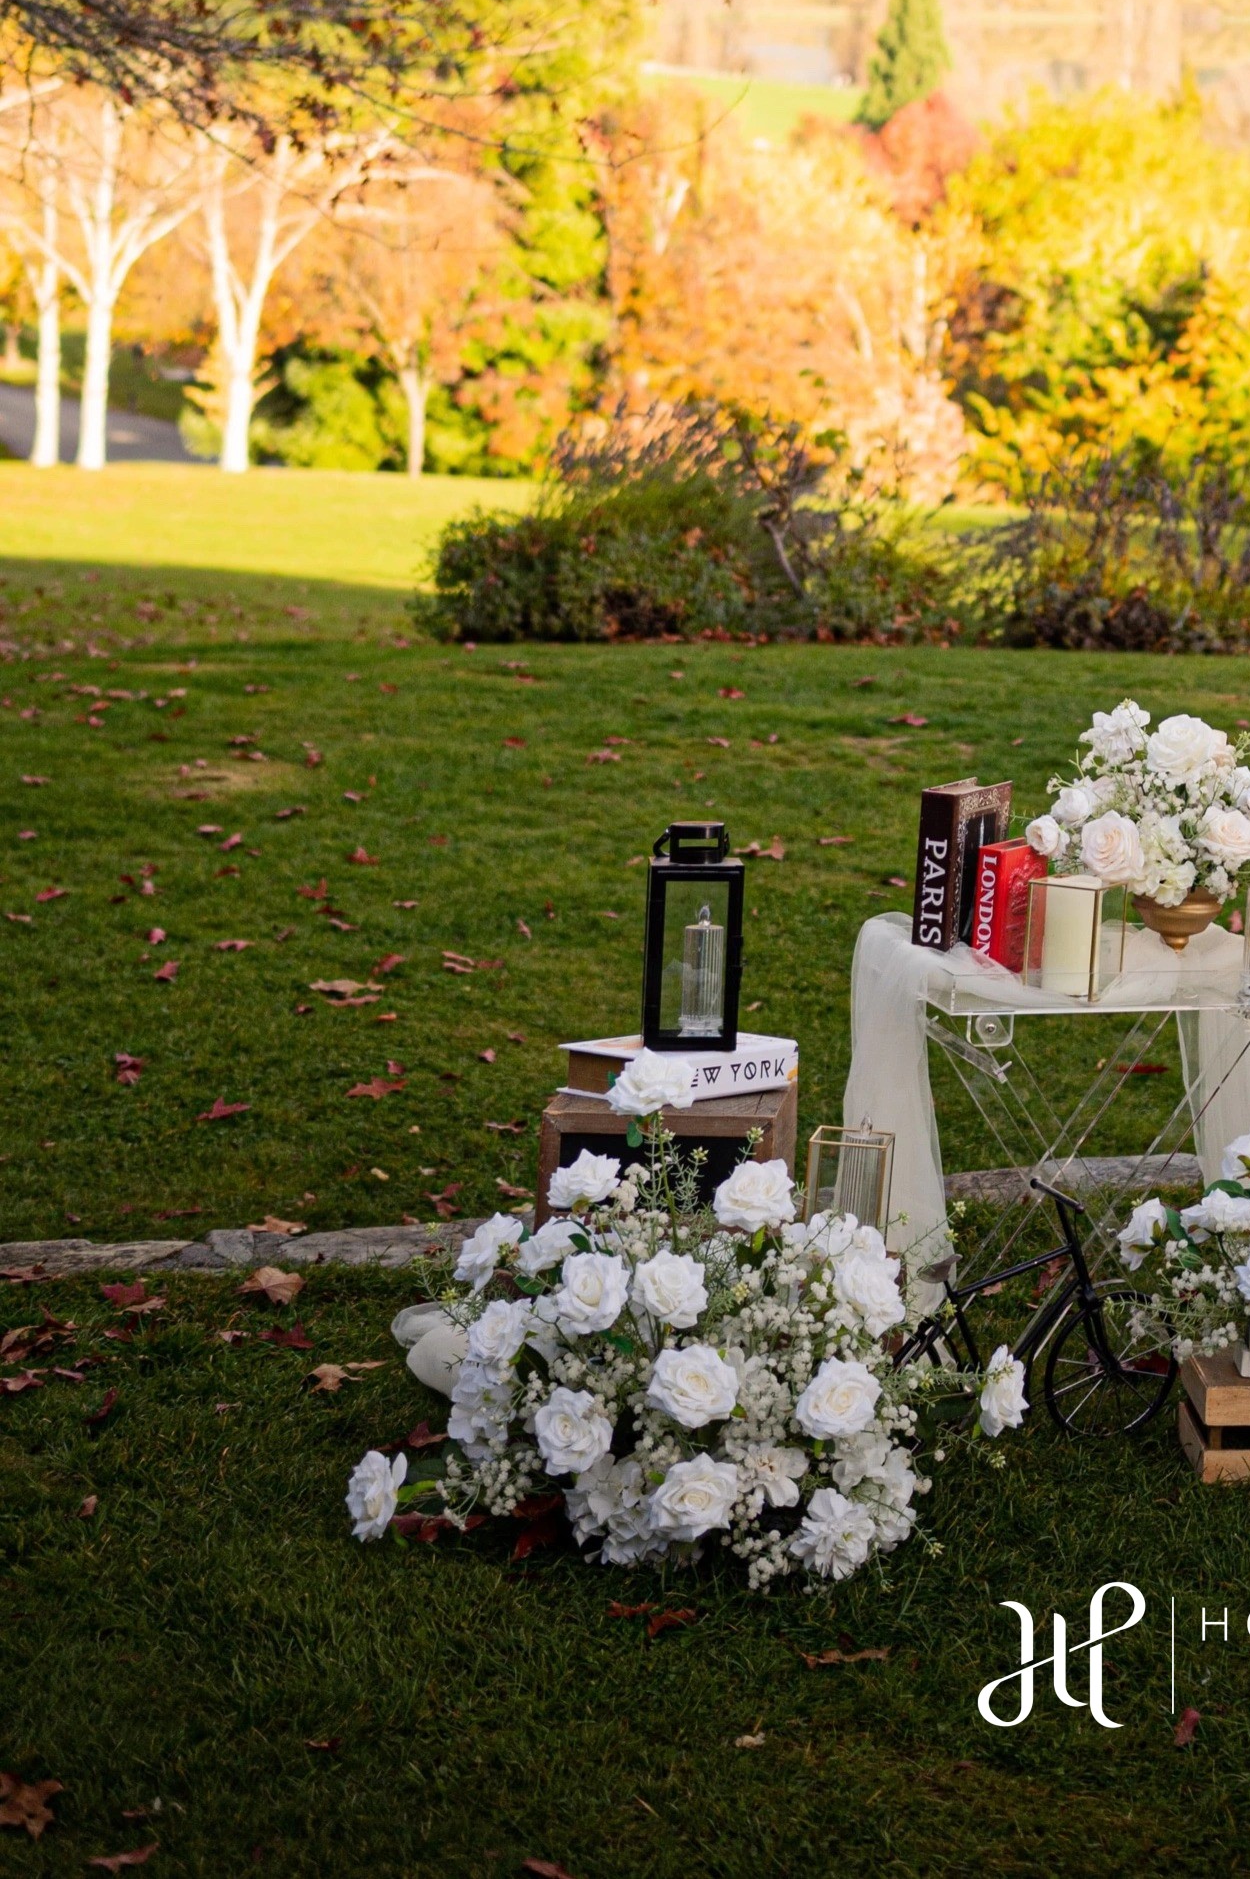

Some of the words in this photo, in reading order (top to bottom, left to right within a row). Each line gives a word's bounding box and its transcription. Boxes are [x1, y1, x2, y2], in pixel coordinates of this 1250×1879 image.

[919, 836, 948, 945] PARIS
[976, 853, 998, 958] LONDON
[730, 1057, 785, 1082] YORK
